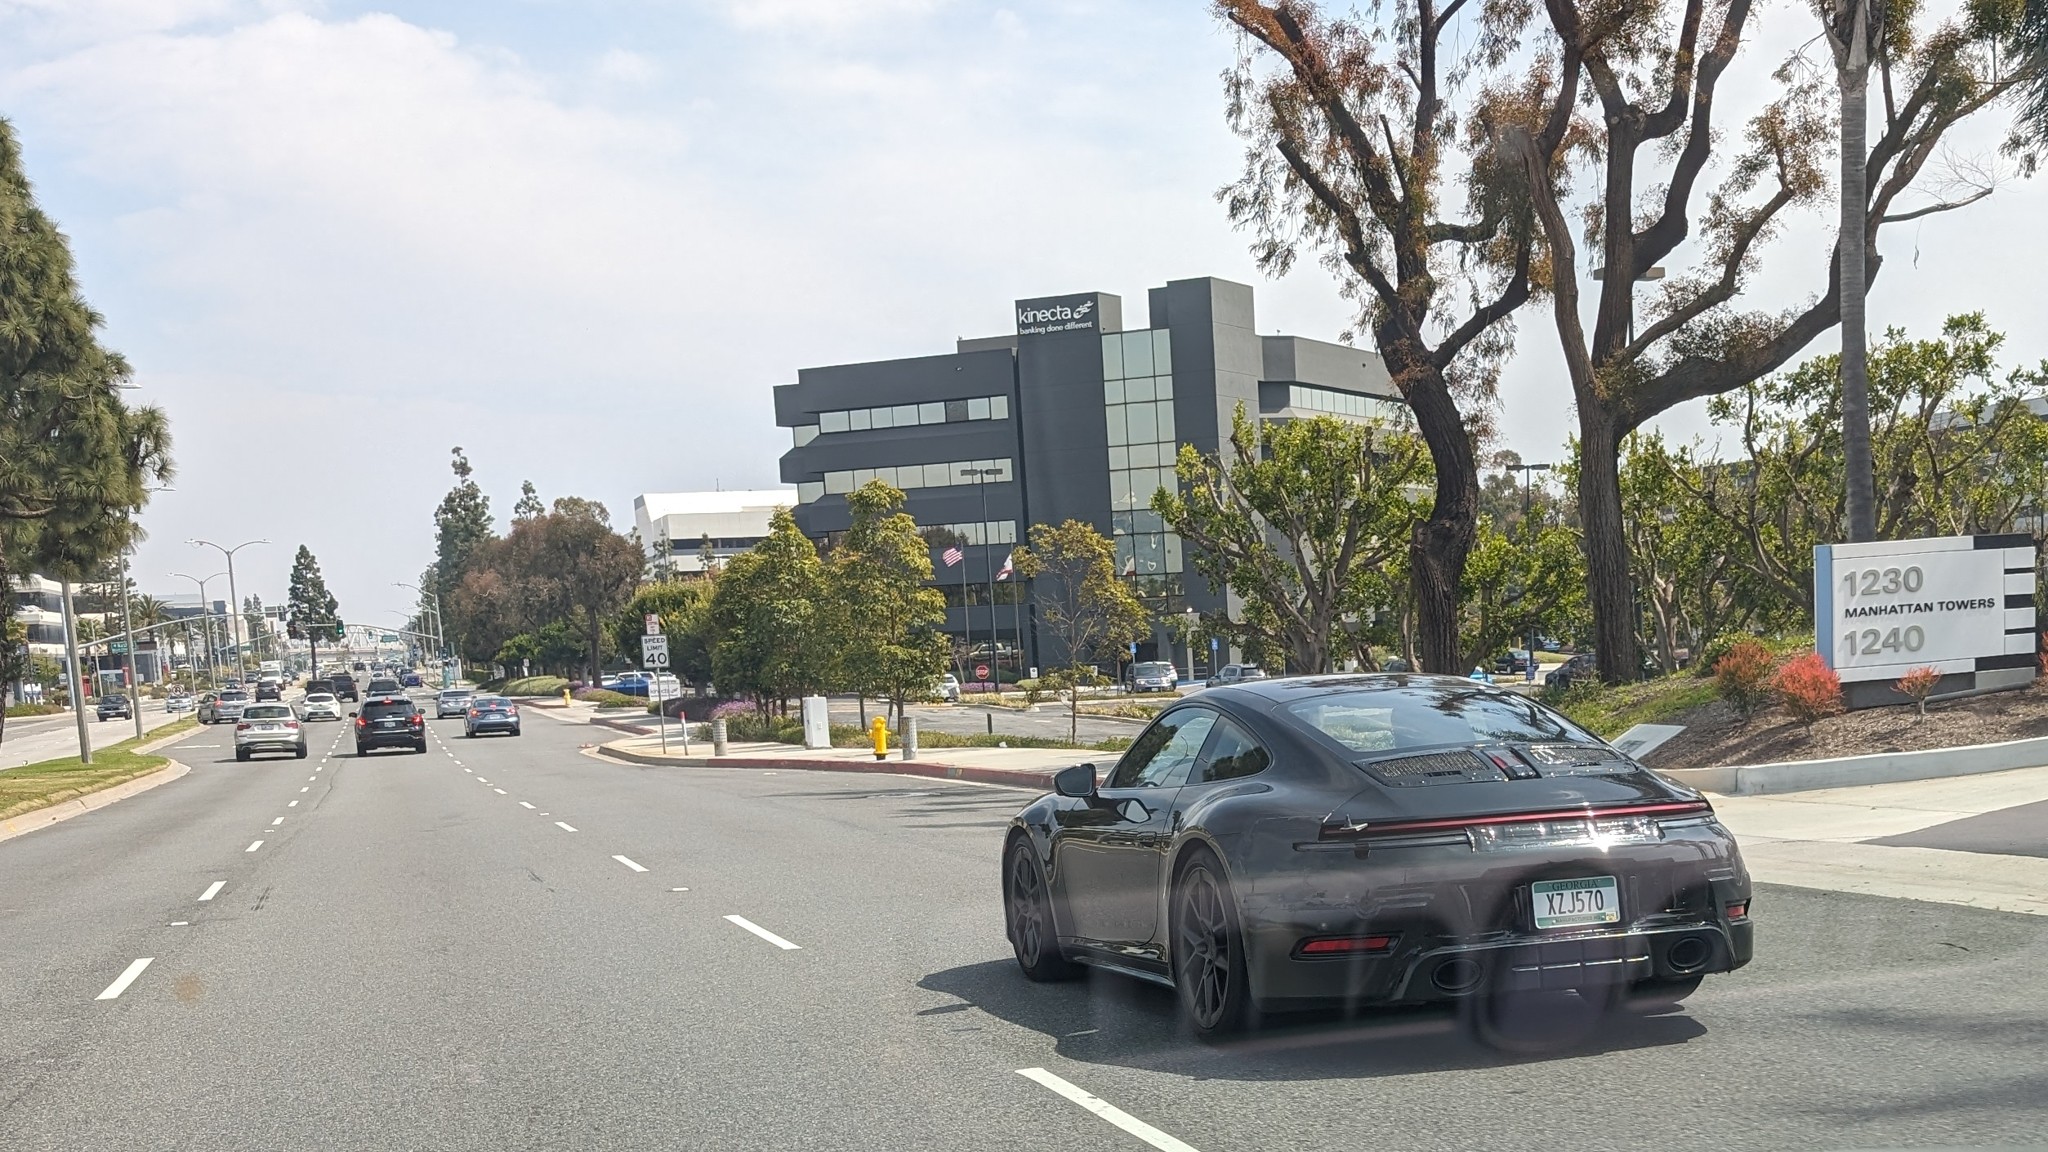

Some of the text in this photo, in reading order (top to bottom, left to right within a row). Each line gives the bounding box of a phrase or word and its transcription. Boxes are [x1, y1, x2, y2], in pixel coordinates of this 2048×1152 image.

[1018, 305, 1071, 324] kinecta
[1020, 321, 1093, 335] banking done different
[1844, 566, 1923, 597] 1230
[1845, 598, 1995, 618] MANHATTAN TOWERS
[1844, 625, 1925, 656] 1240
[646, 652, 667, 664] 40
[1552, 880, 1599, 891] GEORGIA
[1546, 890, 1604, 915] XZJ570
